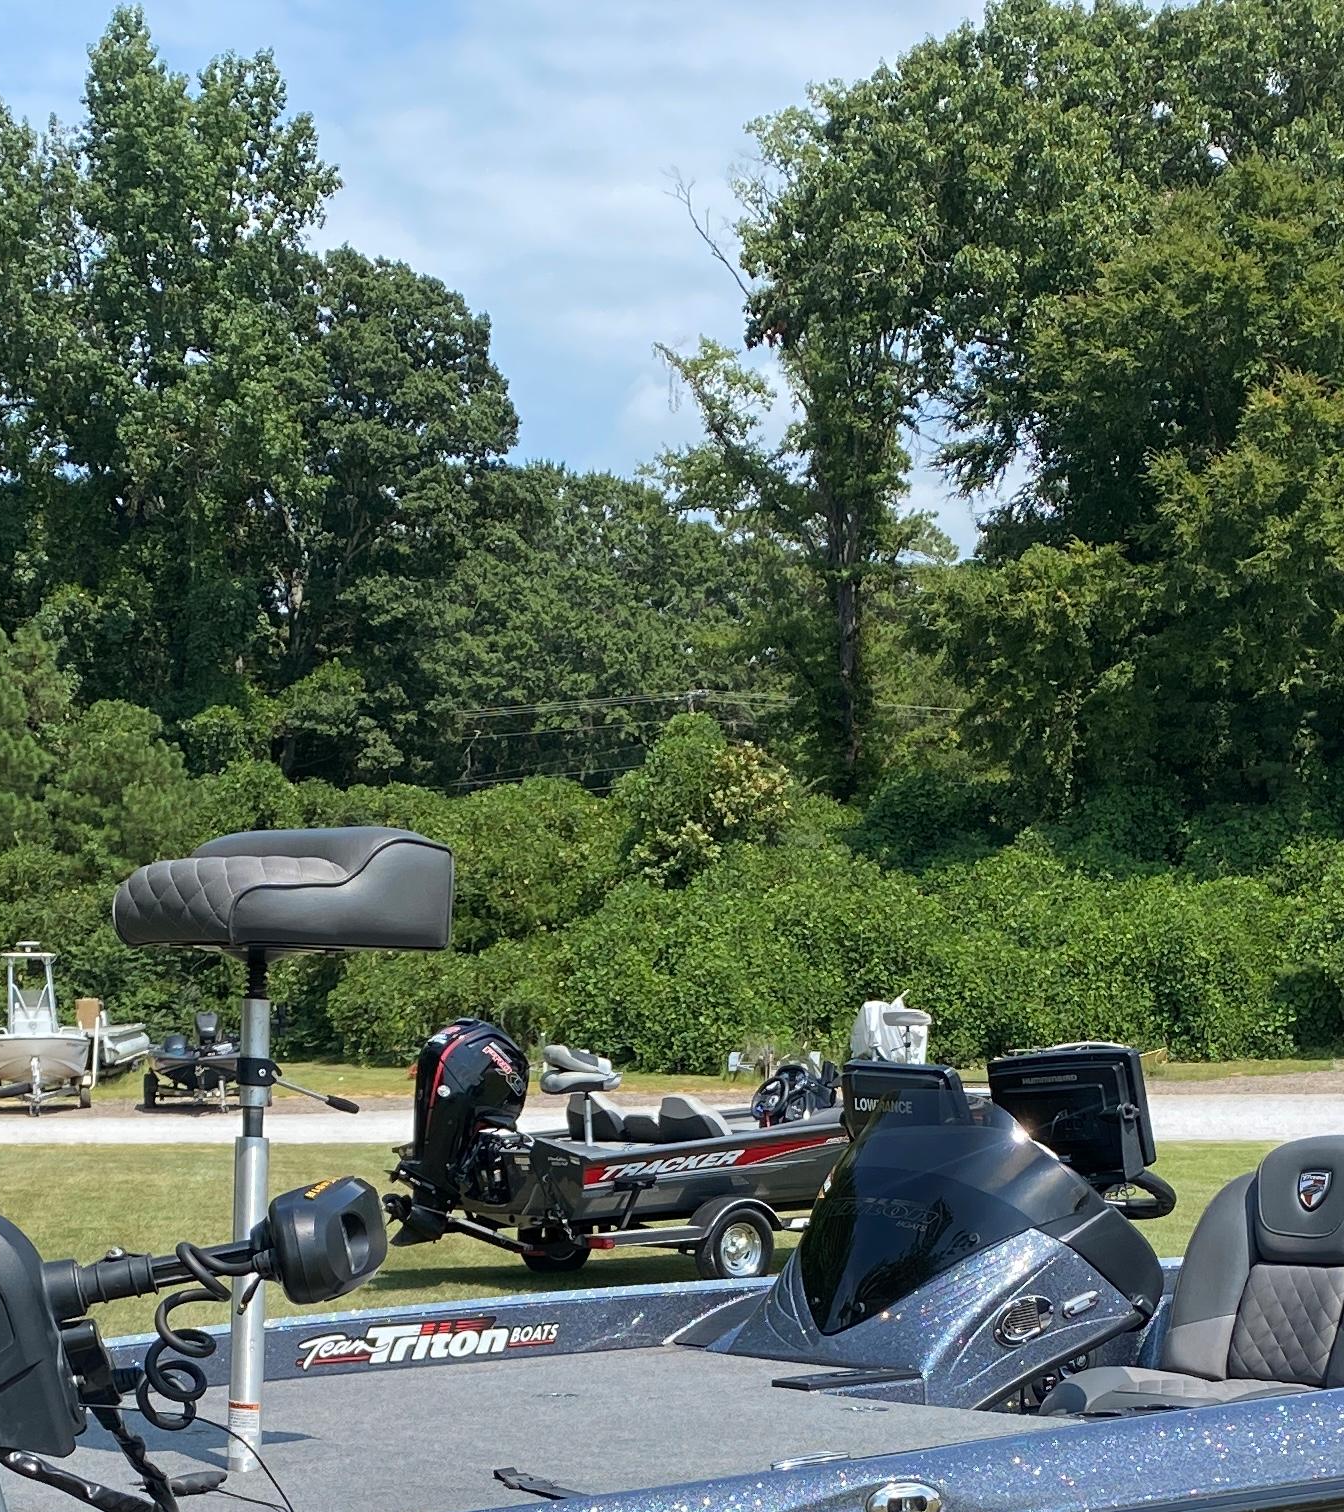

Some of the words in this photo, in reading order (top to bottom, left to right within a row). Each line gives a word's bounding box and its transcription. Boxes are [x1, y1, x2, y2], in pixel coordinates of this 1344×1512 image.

[854, 1097, 913, 1114] LOWRANCE
[599, 1149, 746, 1181] TRACKER
[299, 1334, 380, 1370] Team
[366, 1322, 510, 1364] Triton
[510, 1324, 560, 1344] BOATS
